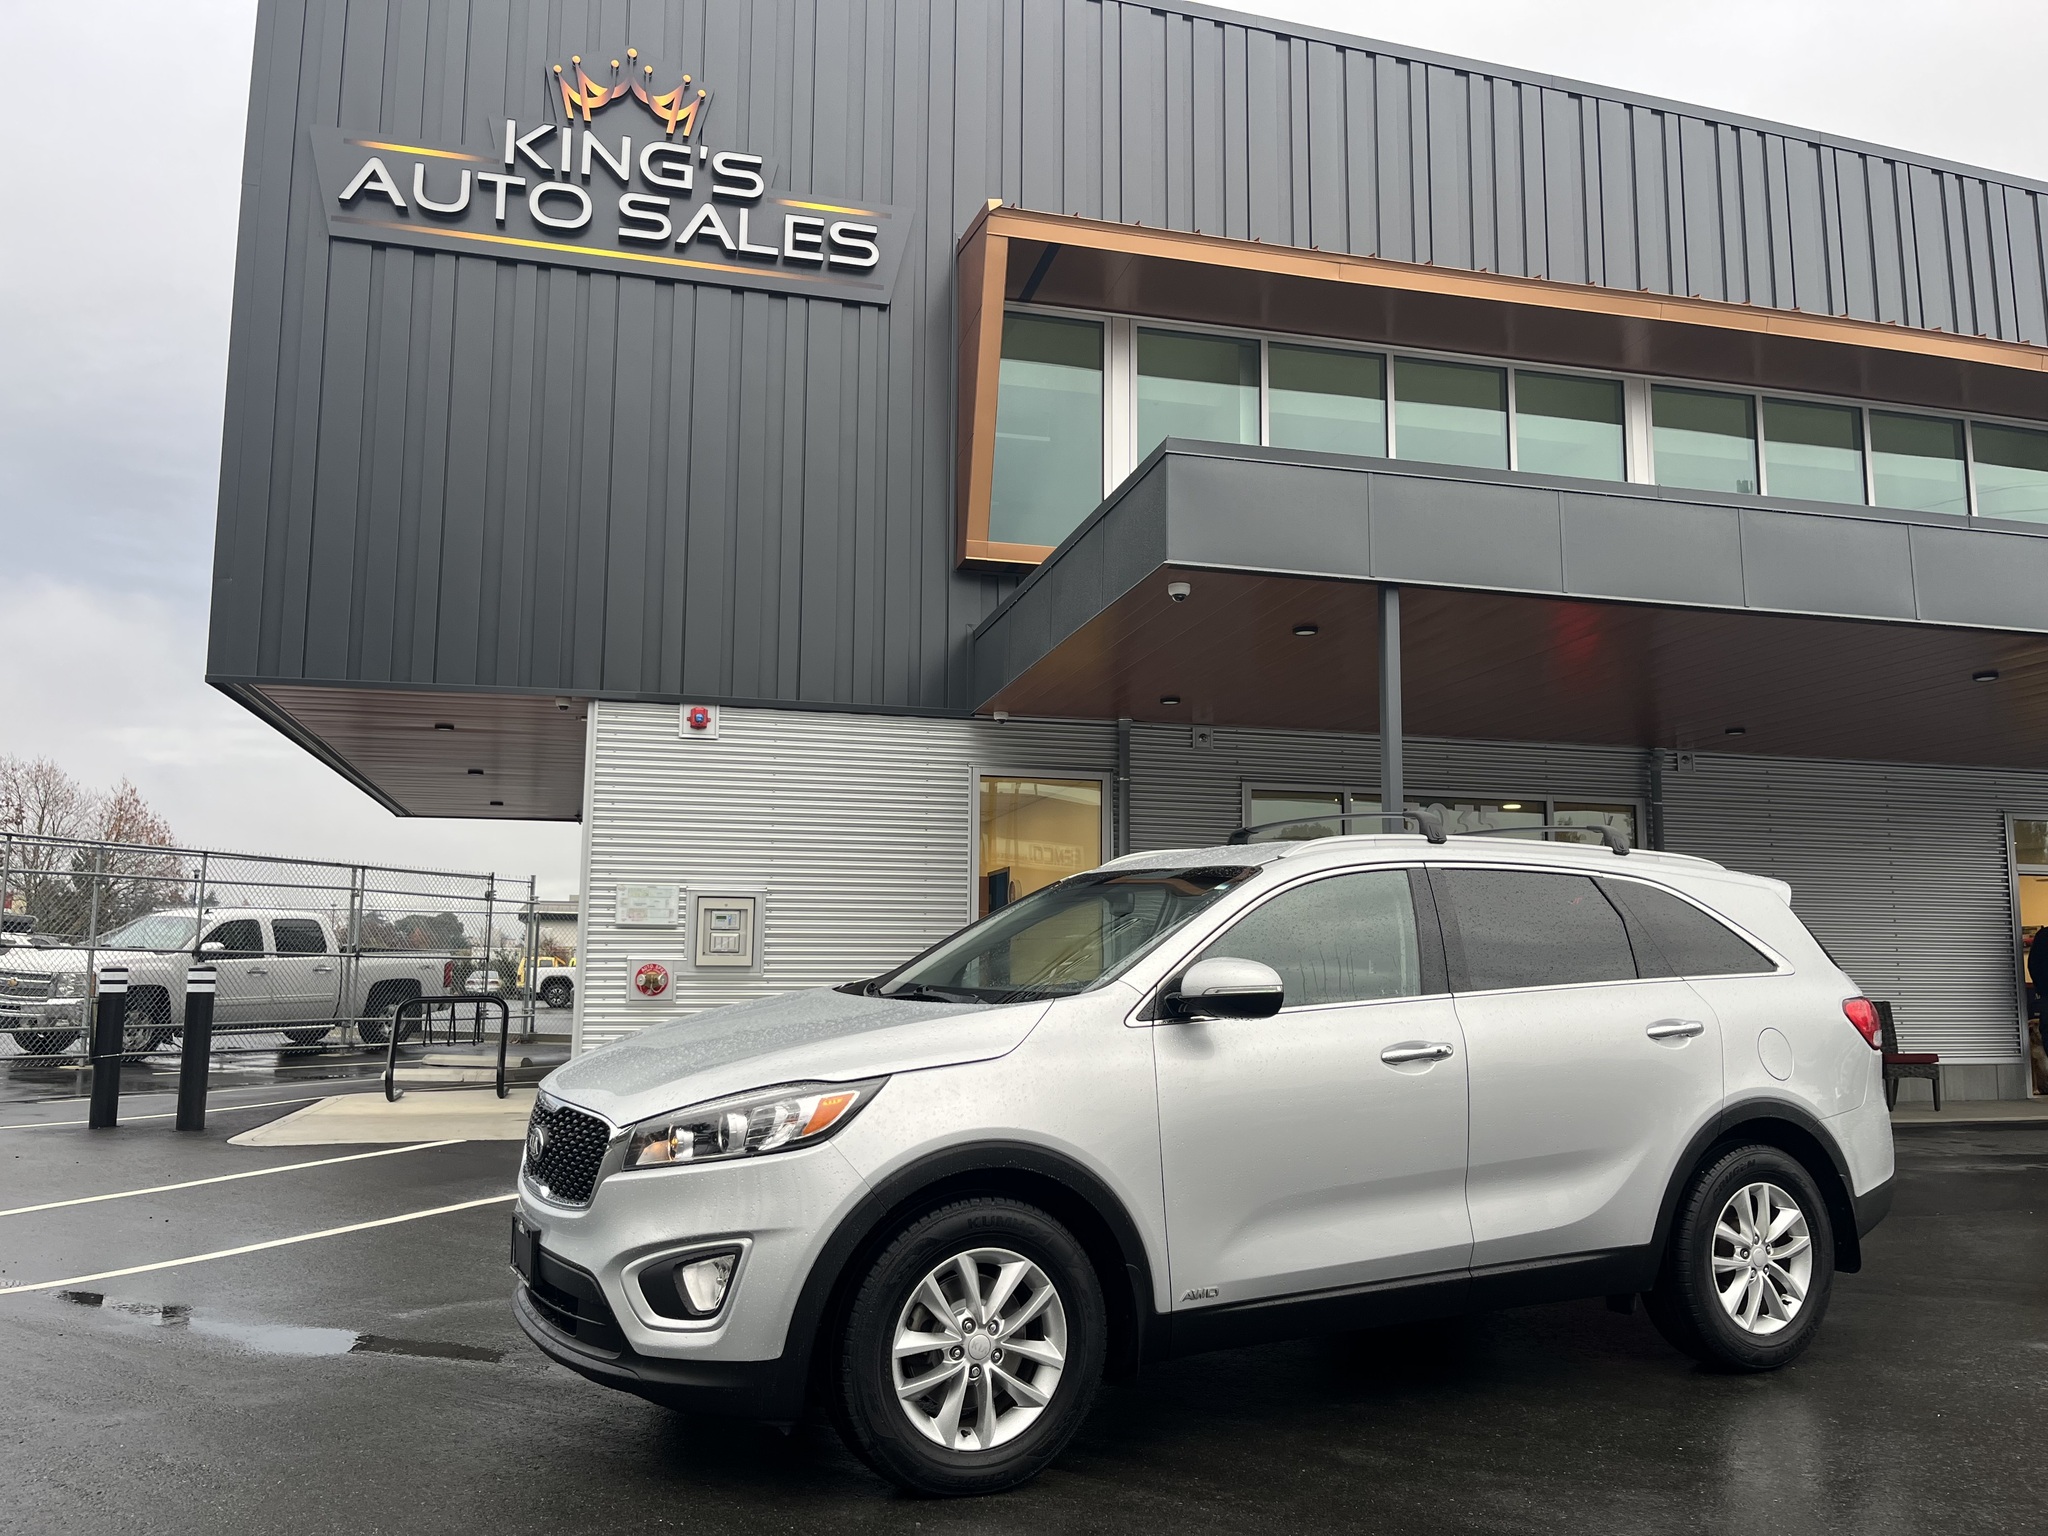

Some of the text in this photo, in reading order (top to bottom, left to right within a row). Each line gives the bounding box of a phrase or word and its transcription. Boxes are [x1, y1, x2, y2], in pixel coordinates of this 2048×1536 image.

[505, 119, 765, 199] KING'S
[338, 157, 880, 268] AUTO SALES
[1180, 1286, 1219, 1302] AWD
